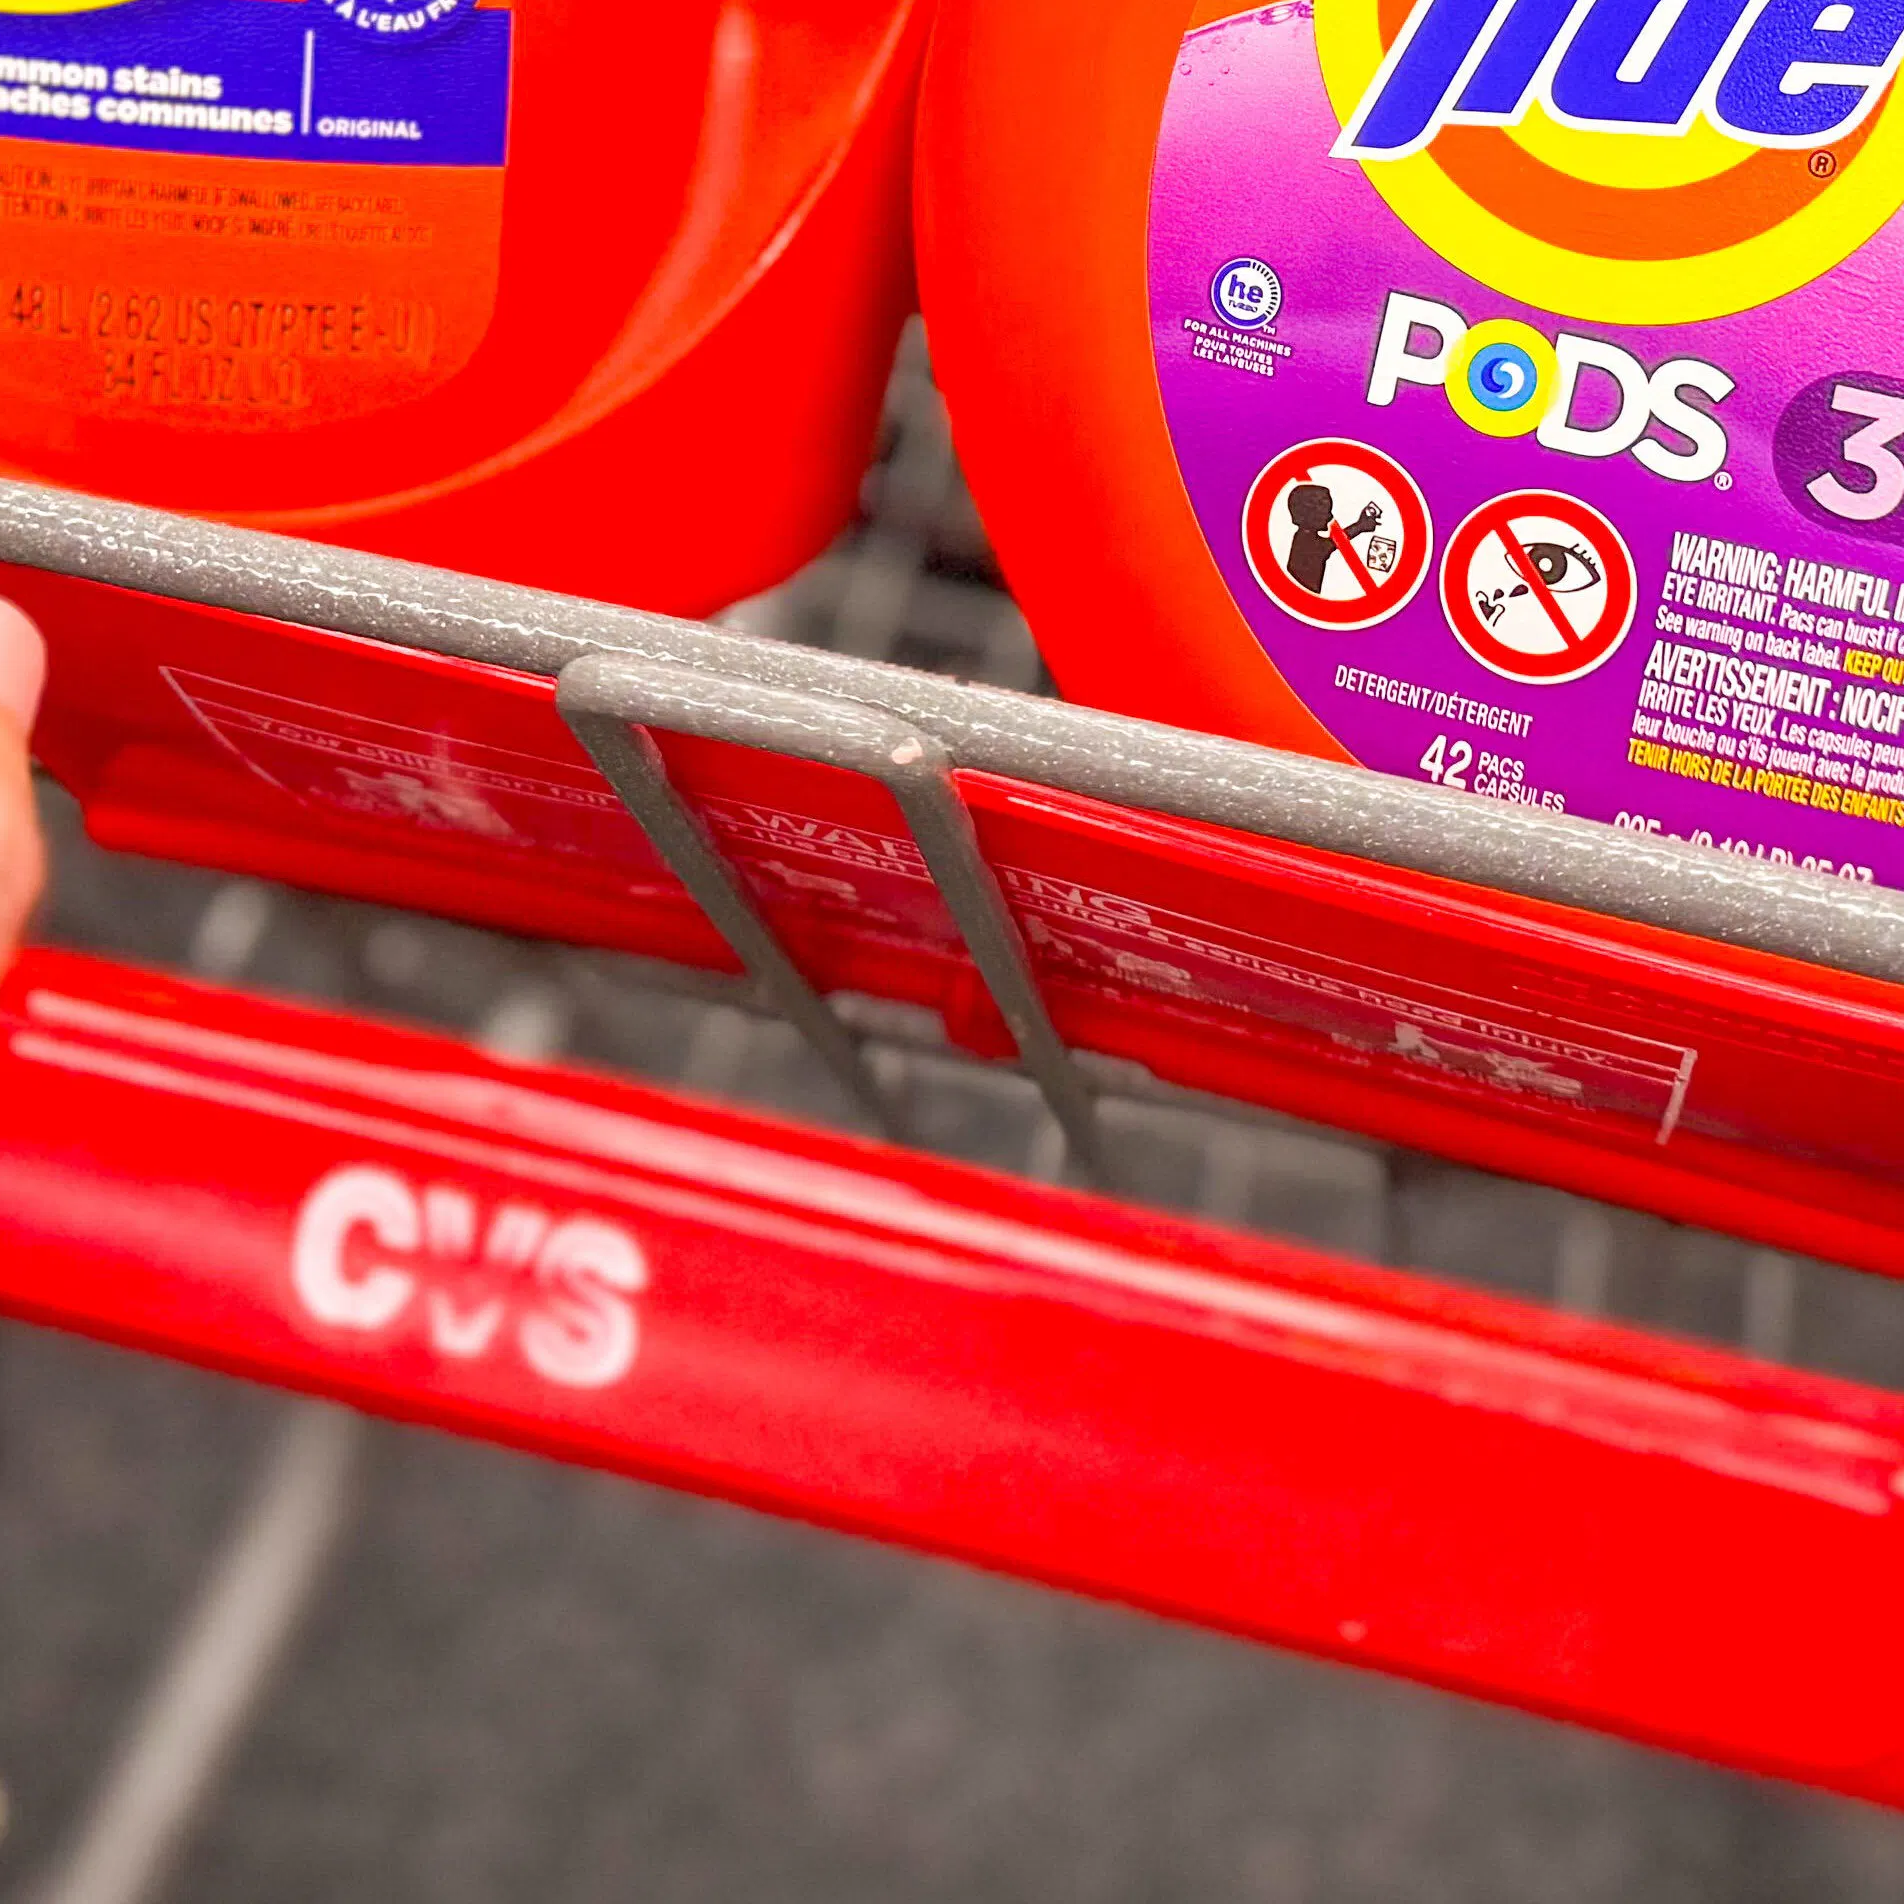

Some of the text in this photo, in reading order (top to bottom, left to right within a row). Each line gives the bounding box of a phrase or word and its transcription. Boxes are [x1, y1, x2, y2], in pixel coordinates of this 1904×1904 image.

[356, 8, 425, 32] L'EAU
[112, 62, 224, 101] stains
[94, 94, 293, 136] communes
[316, 116, 424, 140] ORIGINAL
[1227, 273, 1264, 303] he
[1183, 318, 1292, 358] FOR ALL MACHINES
[1193, 345, 1275, 377] LES LAVEUSES
[1195, 335, 1273, 367] POUR TOUTES
[1366, 290, 1737, 482] PODS
[1668, 531, 1782, 596] WARNING:
[1783, 558, 1890, 619] HARMFUL
[1656, 605, 1683, 633] See
[1685, 617, 1744, 653] warning
[1745, 632, 1764, 652] on
[1765, 631, 1801, 661] back
[1802, 639, 1840, 670] label.
[1843, 648, 1883, 678] KEEP
[1662, 572, 1698, 605] EYE
[1696, 580, 1777, 624] IRRITANT.
[1779, 603, 1815, 633] Pacs
[1816, 616, 1844, 640] can
[1844, 618, 1885, 650] burst
[1334, 664, 1534, 738] DETERGENT/DÉTERGENT
[1644, 640, 1831, 717] AVERTISSEMENT
[1632, 709, 1662, 737] leur
[1663, 716, 1716, 751] bouche
[1717, 735, 1736, 757] ou
[1766, 743, 1816, 777] jouent
[1638, 679, 1696, 718] IRRITE
[1695, 692, 1729, 726] LES
[1732, 700, 1777, 738] YEUX.
[1808, 728, 1872, 761] capsules
[1419, 734, 1525, 790] 42 PACS
[1628, 738, 1670, 772] TENIR
[1670, 749, 1711, 781] HORS
[1711, 759, 1733, 787] DE
[1732, 764, 1752, 791] LA
[1810, 782, 1841, 811] DES
[1473, 774, 1566, 814] CAPSULES
[291, 1166, 649, 1390] CVS
